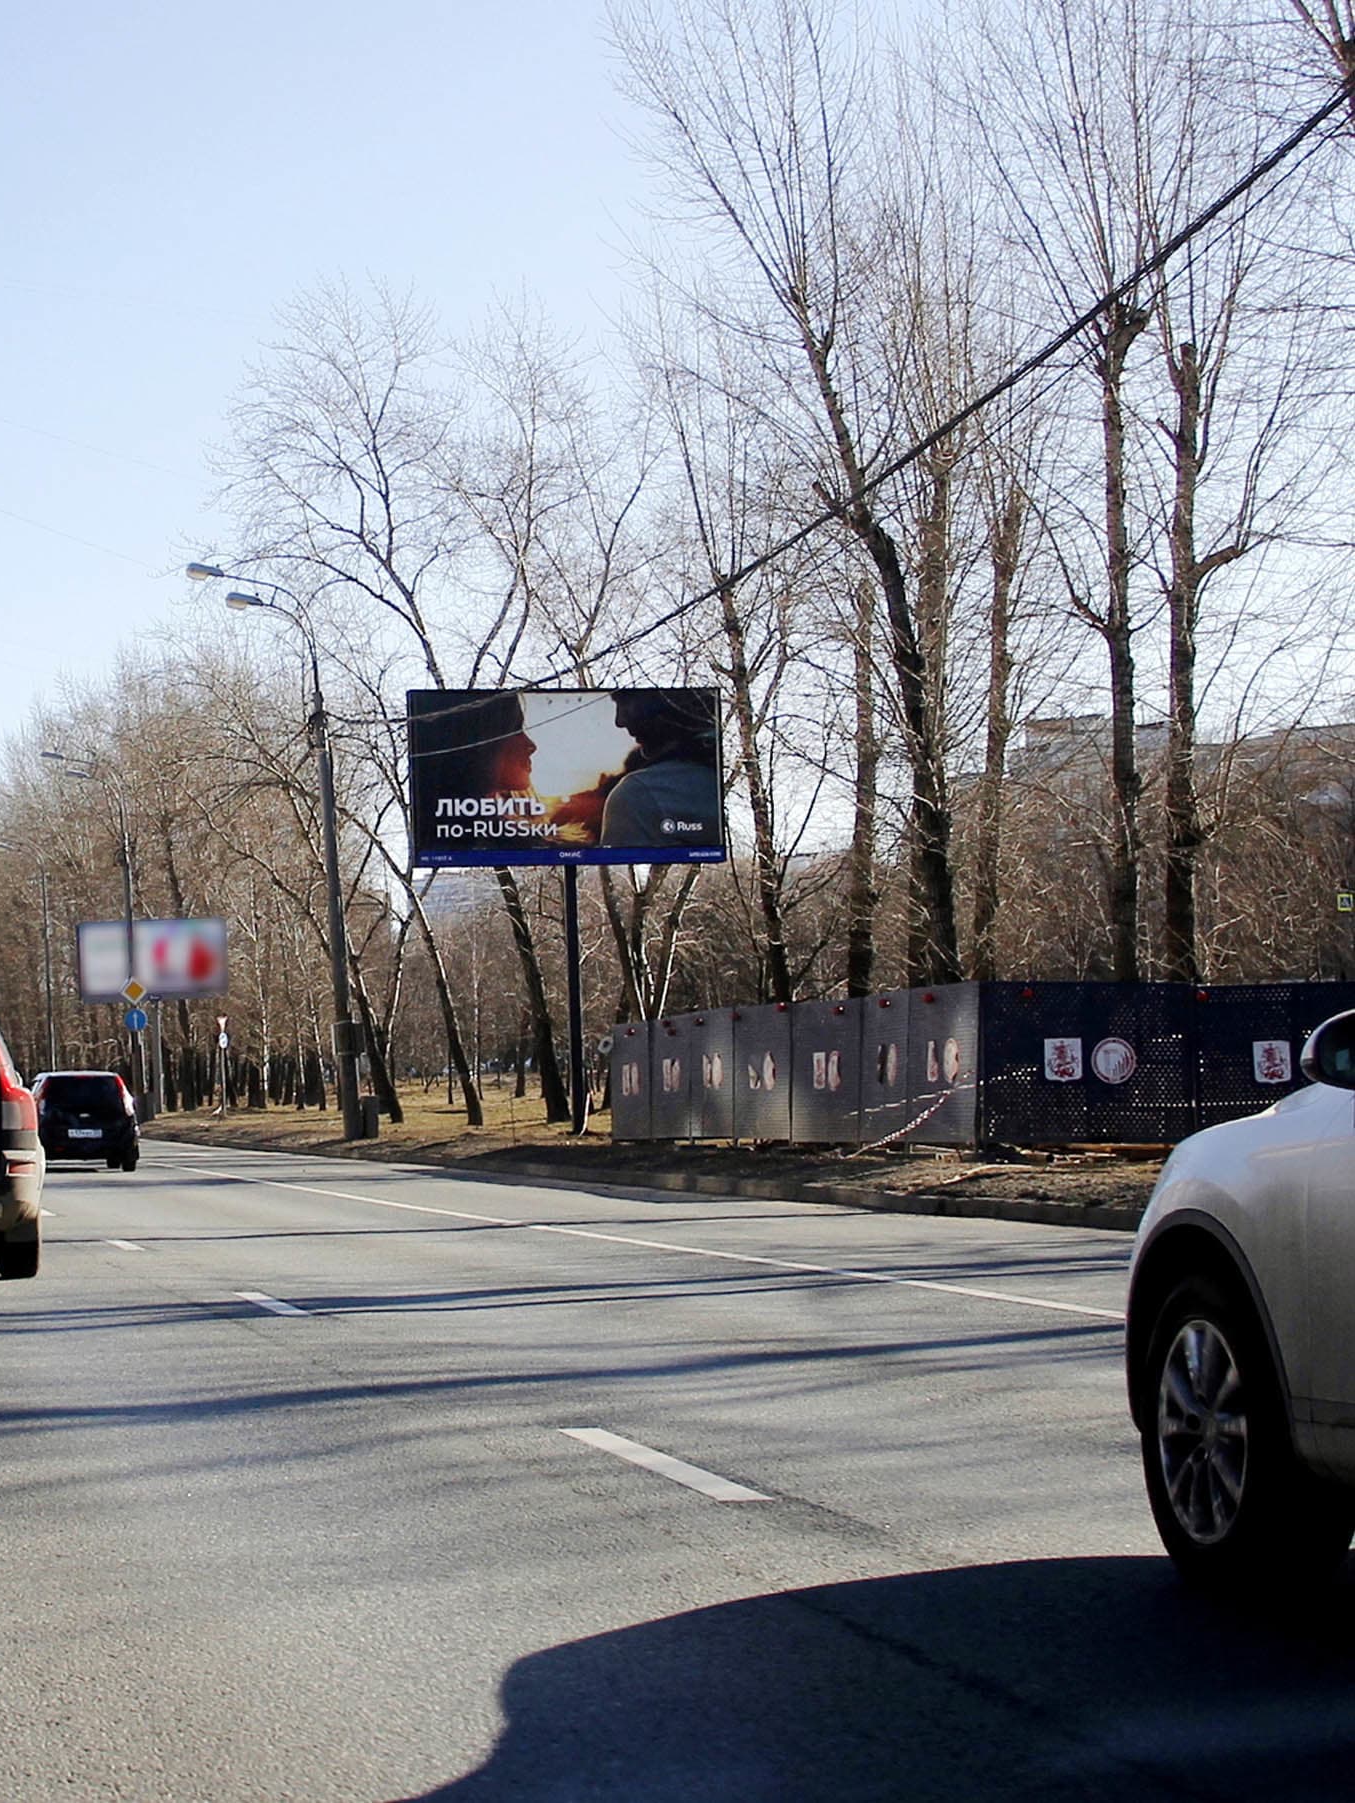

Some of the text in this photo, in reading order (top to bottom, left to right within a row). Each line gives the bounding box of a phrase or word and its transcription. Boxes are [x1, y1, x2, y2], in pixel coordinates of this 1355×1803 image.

[435, 797, 547, 817] ЛЮБИТЬ
[436, 820, 557, 838] по-RUSSки
[676, 821, 703, 831] Russ
